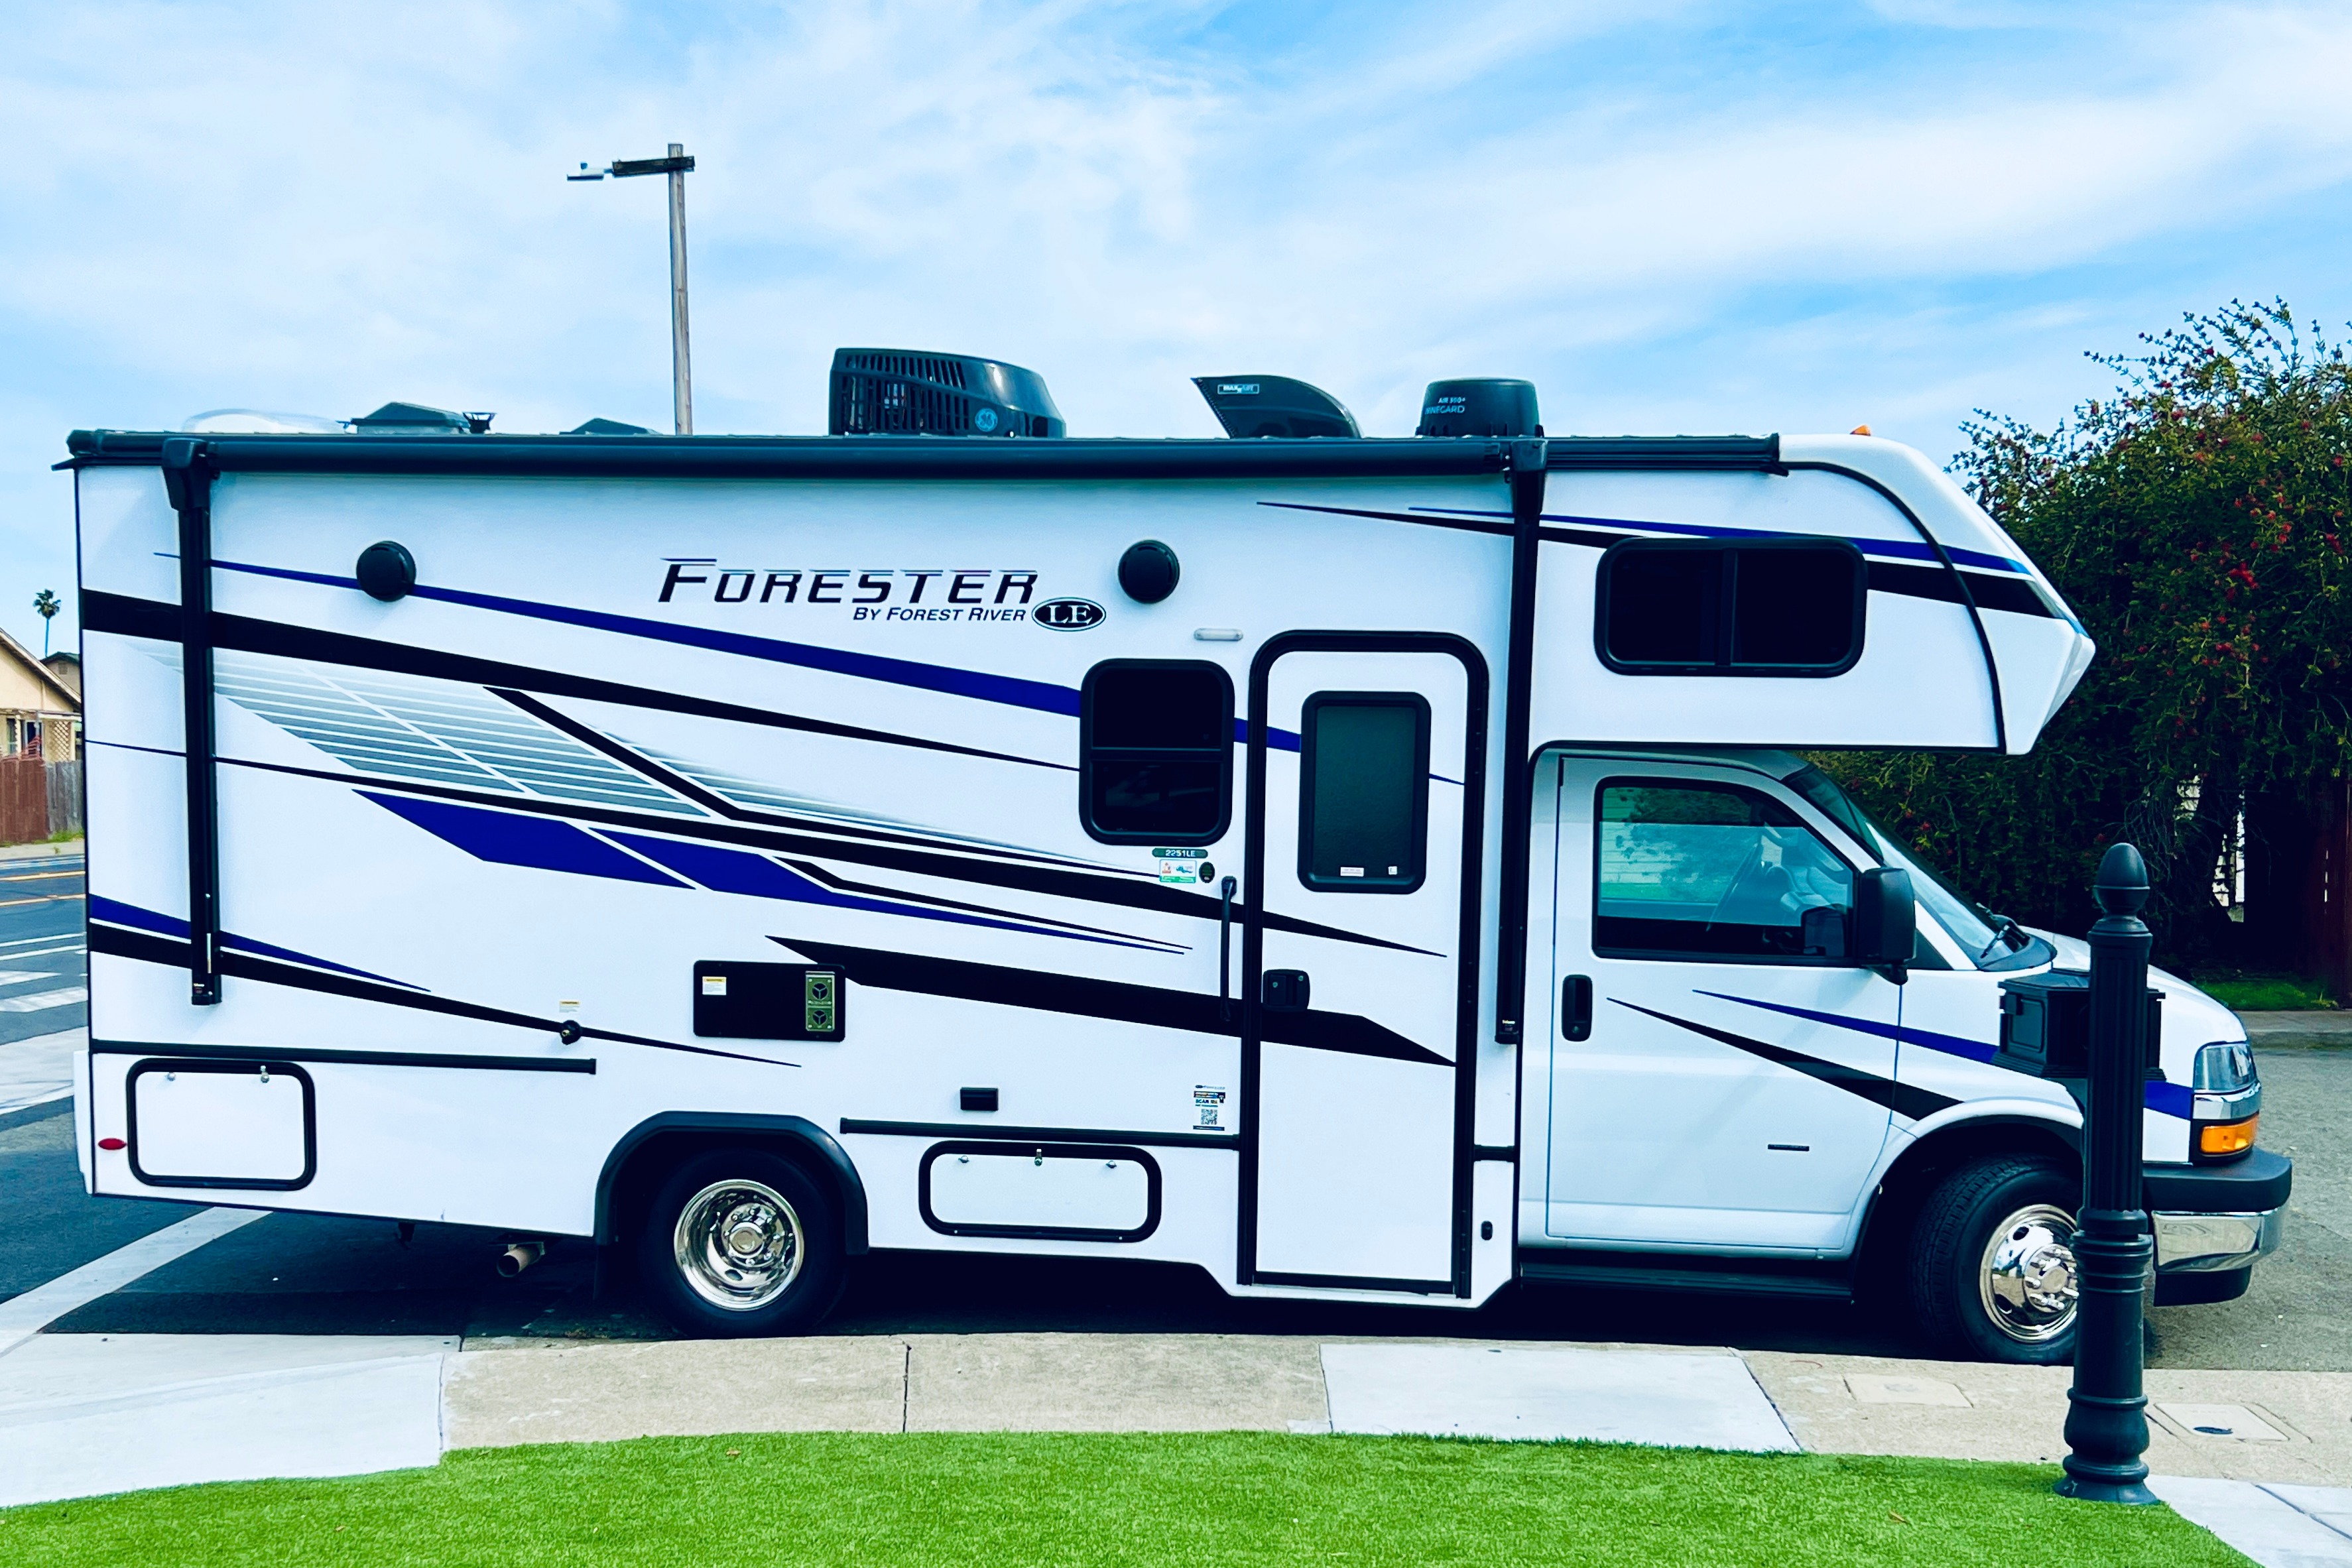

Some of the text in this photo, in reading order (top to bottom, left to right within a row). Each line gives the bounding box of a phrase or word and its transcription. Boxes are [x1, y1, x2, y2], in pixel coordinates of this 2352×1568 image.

[658, 558, 1038, 604] FORESTER
[853, 607, 1026, 621] BY FOREST RIVER
[1045, 604, 1093, 625] LE
